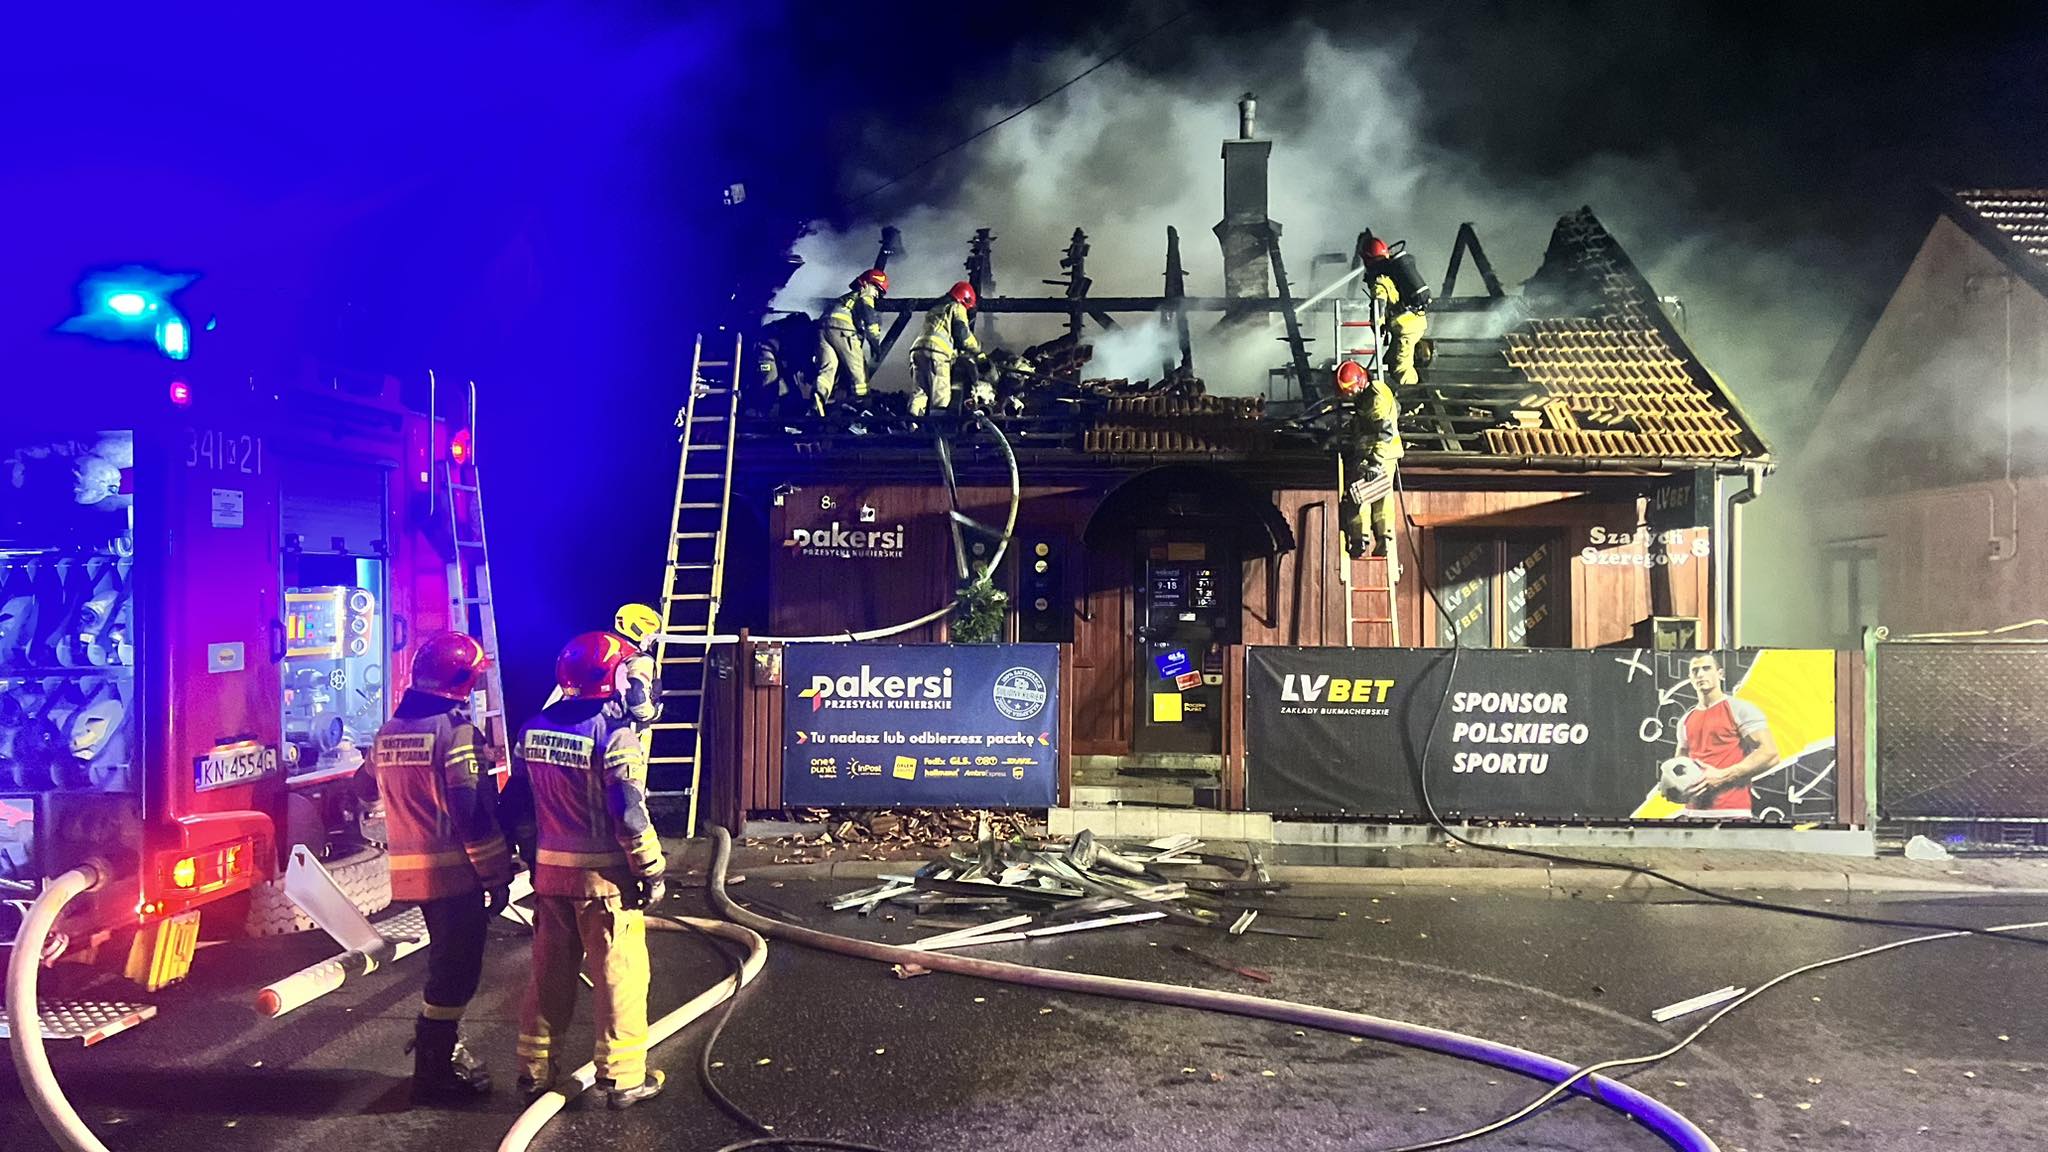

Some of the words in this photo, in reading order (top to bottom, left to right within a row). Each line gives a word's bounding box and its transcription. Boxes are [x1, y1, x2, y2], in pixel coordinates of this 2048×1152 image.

[785, 521, 904, 552] pakersi
[1581, 547, 1688, 569] Szeregów
[1691, 538, 1711, 558] 8
[1508, 544, 1547, 584] LVBET
[1157, 581, 1178, 590] 9-18
[1508, 574, 1548, 614] LVBET
[1508, 604, 1549, 644] LVBET
[799, 664, 953, 708] pakersi
[1281, 674, 1396, 703] LVBET
[824, 700, 883, 709] PRZESYŁKI
[887, 700, 953, 710] KURIERSKIE
[1320, 707, 1390, 716] BUKMACHERSKIE
[1452, 692, 1568, 713] SPONSOR
[810, 731, 826, 743] Tu
[829, 730, 880, 744] nadasz
[883, 730, 906, 744] lub
[909, 731, 983, 744] odbierzesz
[986, 731, 1035, 748] paczkę
[1452, 722, 1590, 745] POLSKIEGO
[204, 759, 225, 785] KN
[229, 750, 273, 779] 4554G
[810, 765, 837, 775] punkt
[1452, 752, 1549, 774] SPORTU
